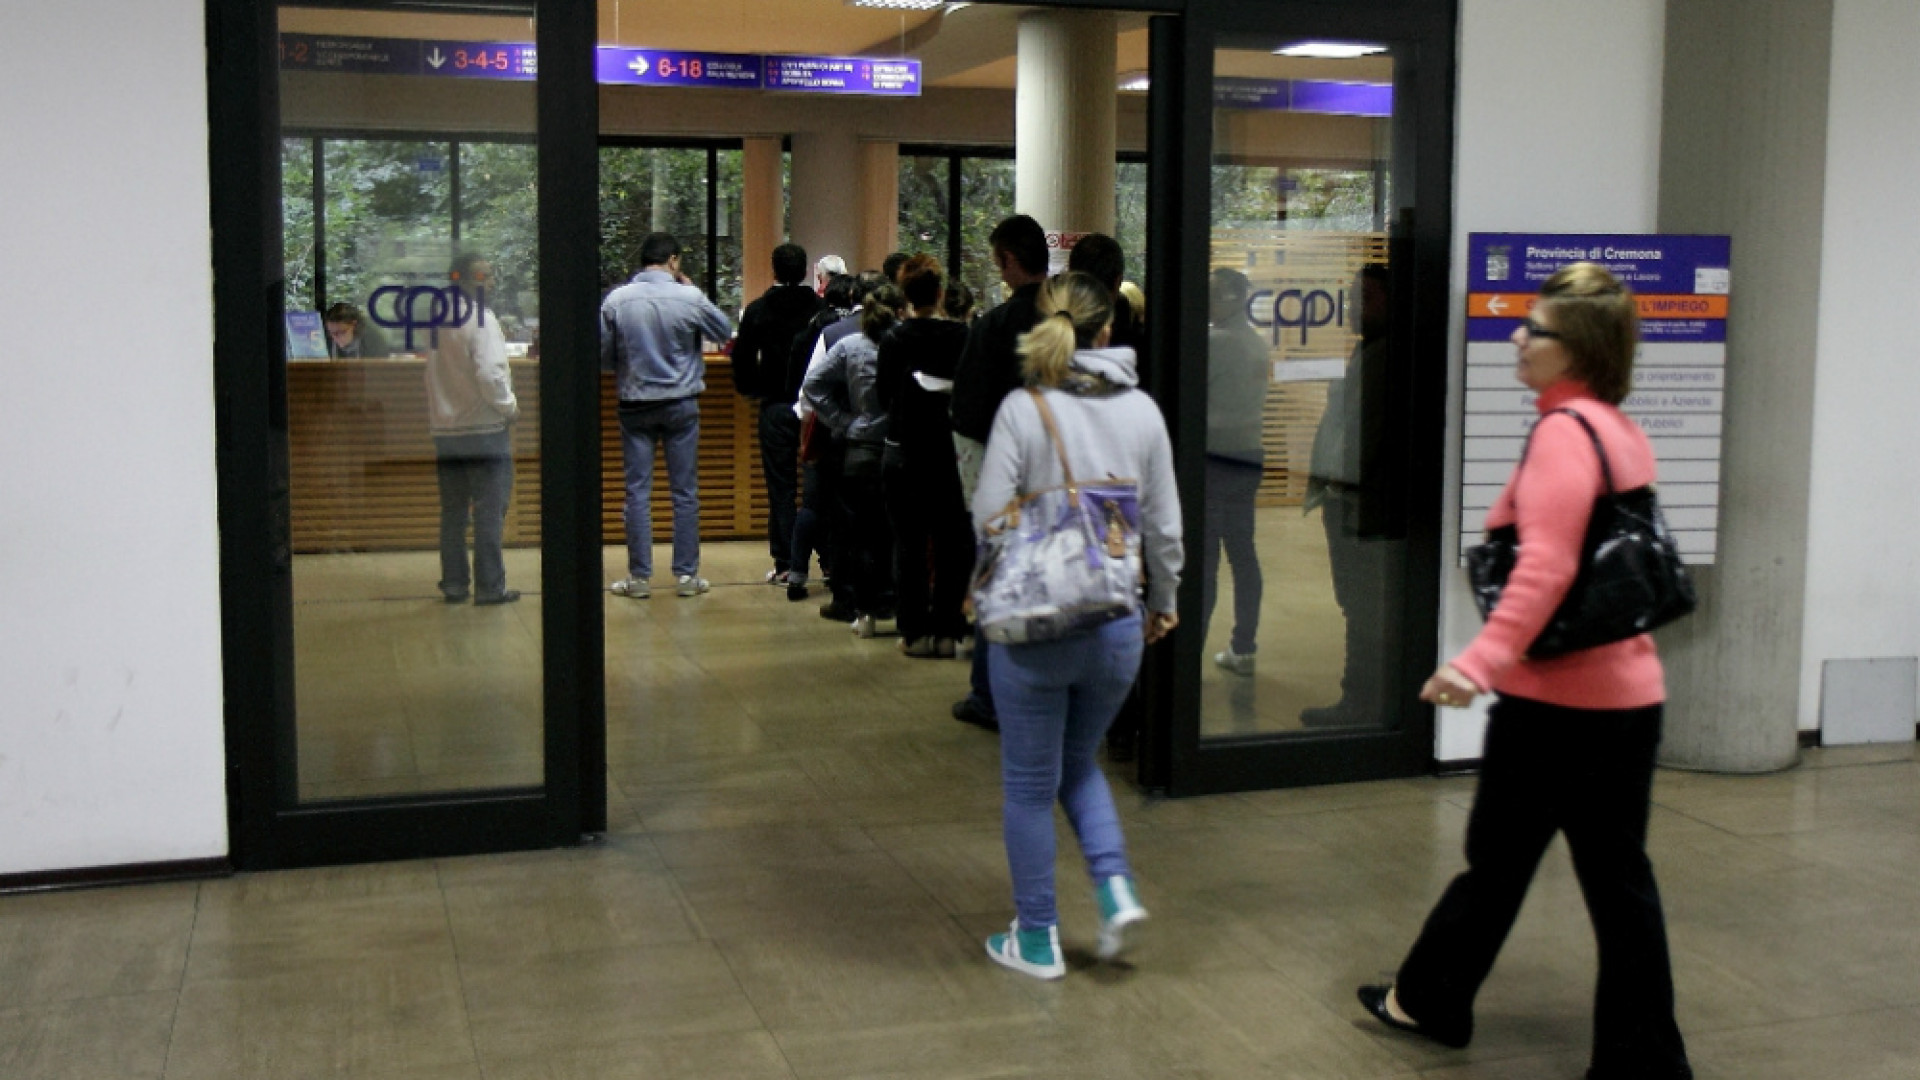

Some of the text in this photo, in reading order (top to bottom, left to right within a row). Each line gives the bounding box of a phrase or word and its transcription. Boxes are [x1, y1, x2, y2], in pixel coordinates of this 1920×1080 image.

[455, 50, 508, 70] 3-4-5
[658, 57, 702, 79] 6-18
[1526, 247, 1662, 260] Provincia di Cremona
[1641, 300, 1709, 313] L'IMPIEGO
[1646, 372, 1716, 384] orientamento
[1623, 396, 1660, 407] ubblici
[1671, 396, 1713, 407] Aziende
[1641, 418, 1684, 429] Pubblici
